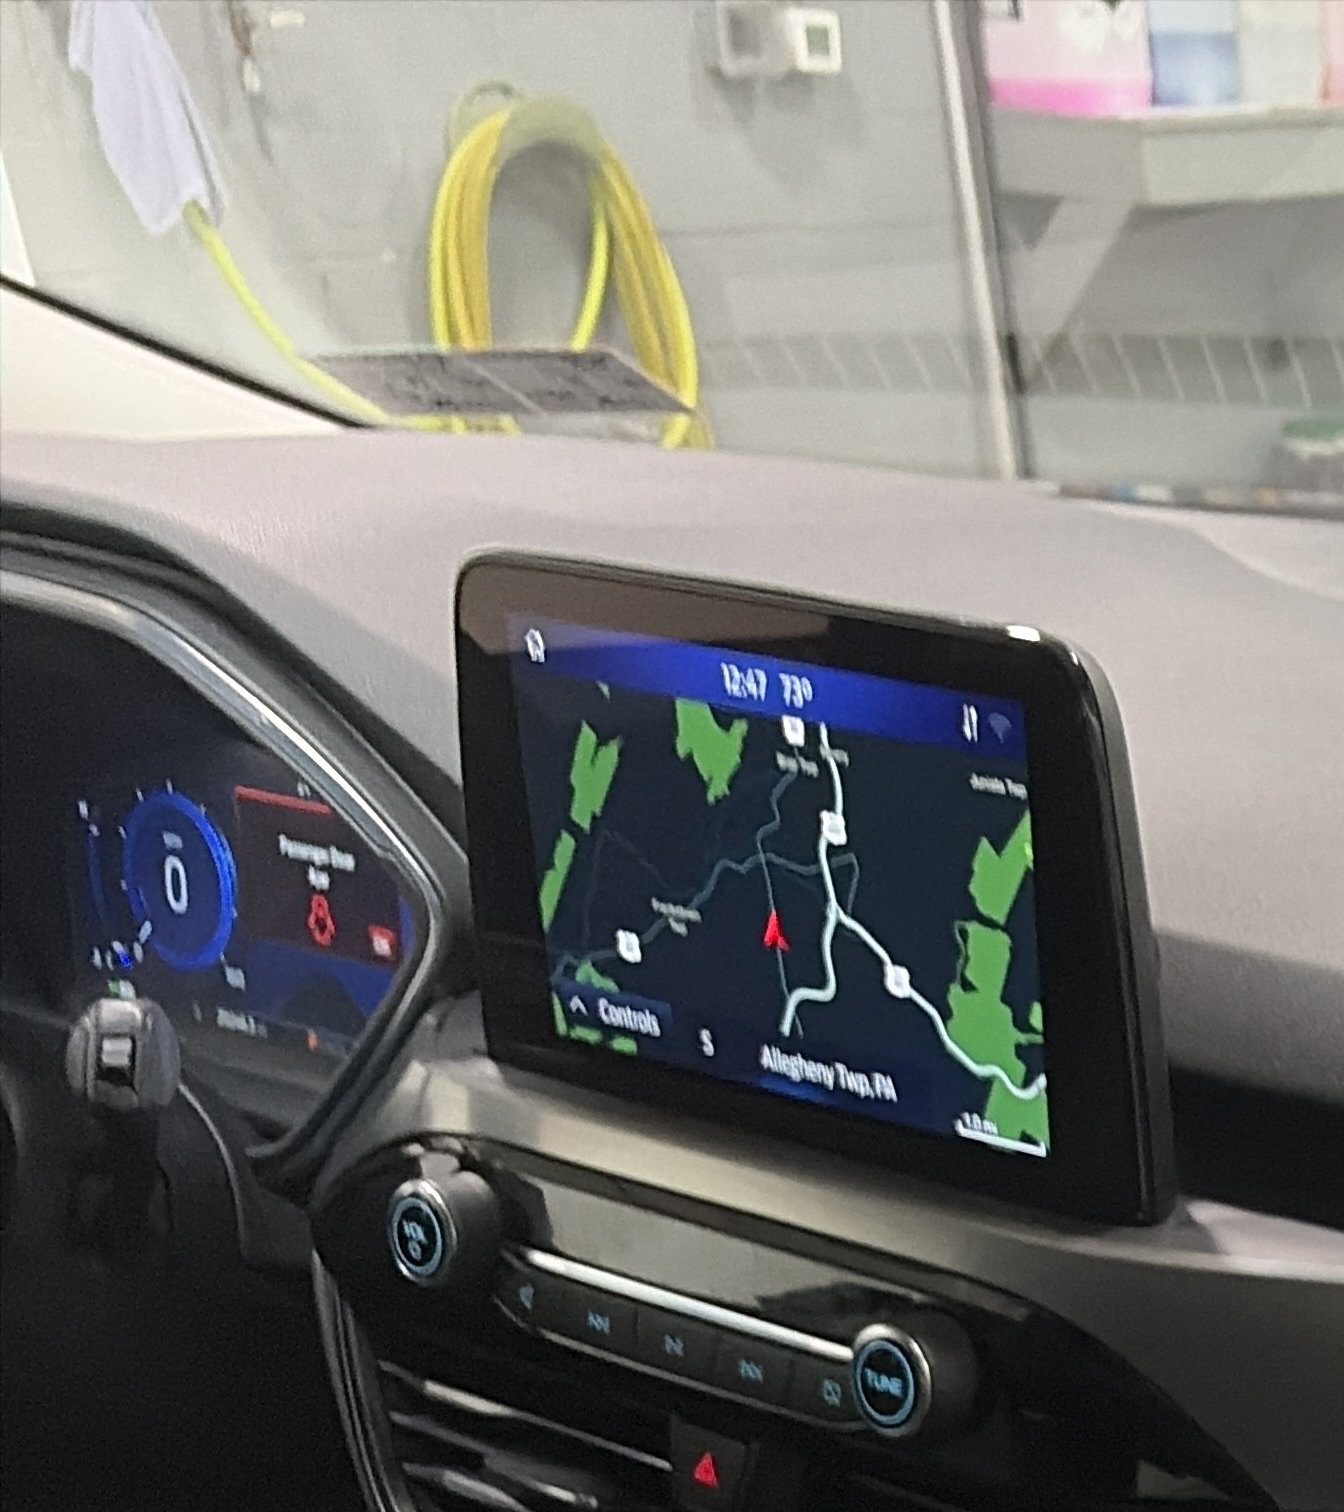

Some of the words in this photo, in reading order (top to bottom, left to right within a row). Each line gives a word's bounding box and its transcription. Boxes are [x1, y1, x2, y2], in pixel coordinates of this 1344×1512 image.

[720, 661, 768, 703] 12:47
[164, 854, 188, 914] 0
[598, 997, 662, 1038] Controls
[699, 1028, 715, 1057] S
[760, 1043, 835, 1091] Allegheny
[864, 1366, 905, 1400] TUNE
